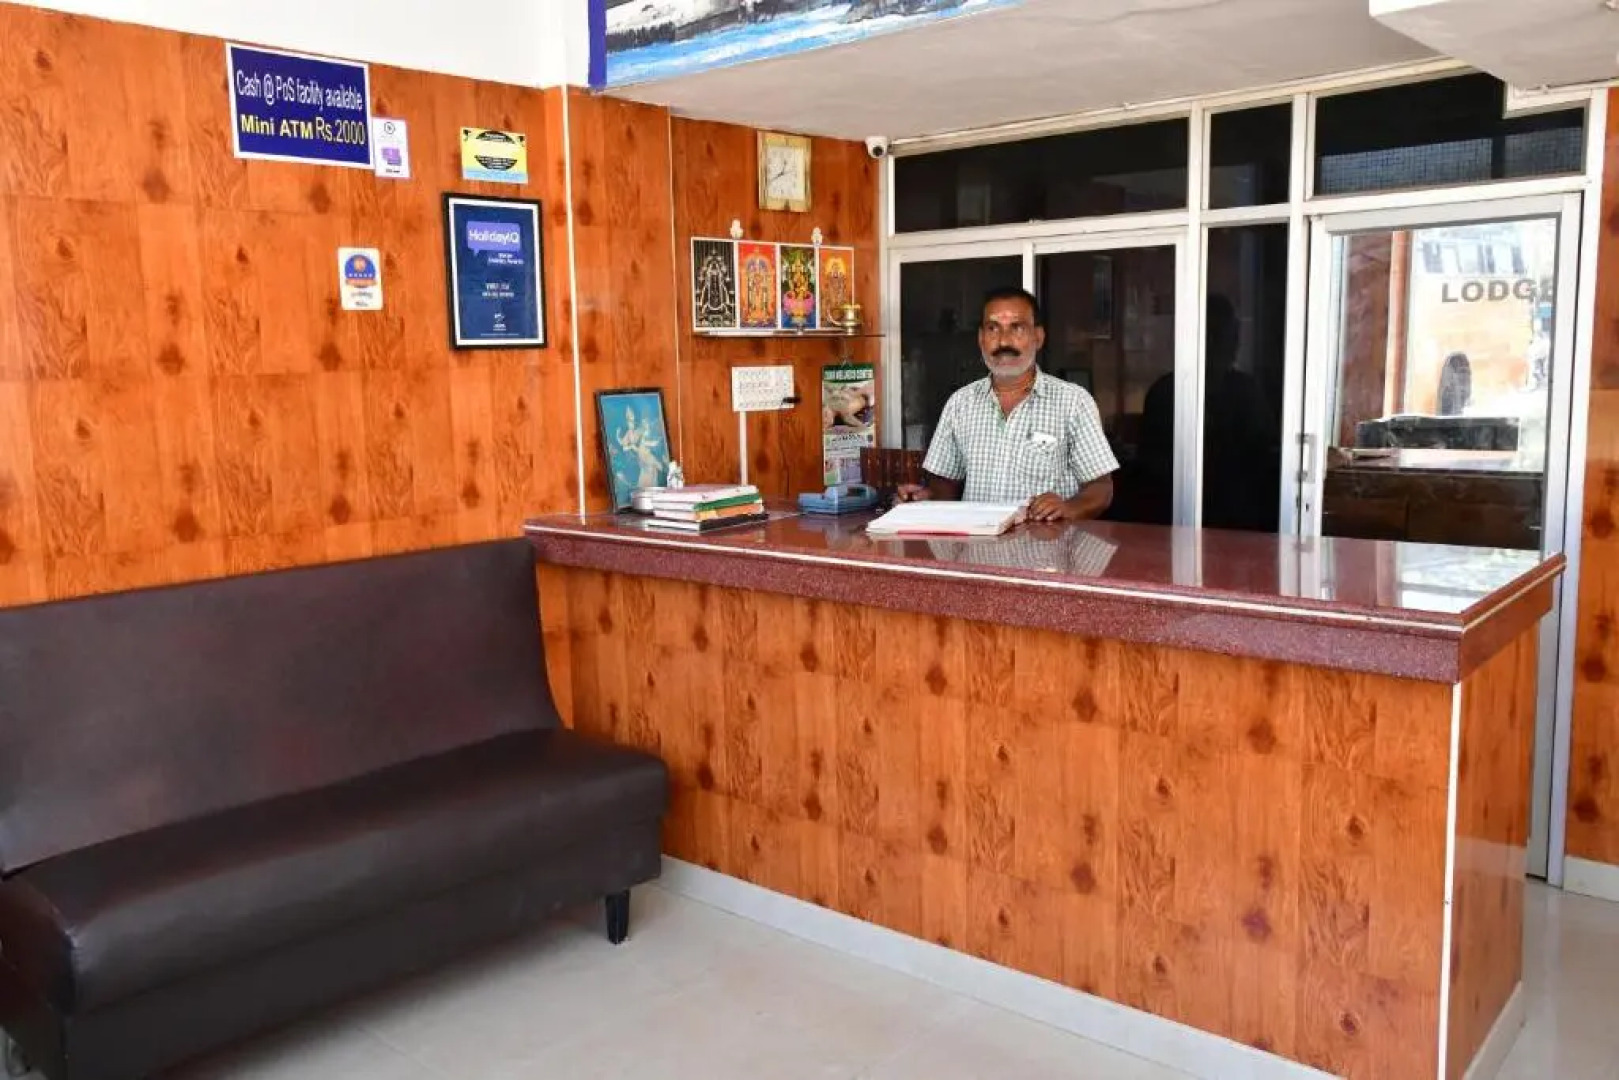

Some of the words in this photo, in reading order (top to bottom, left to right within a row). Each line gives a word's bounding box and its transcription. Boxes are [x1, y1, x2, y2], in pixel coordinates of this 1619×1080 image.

[236, 69, 261, 97] Cash
[263, 74, 275, 105] @
[276, 75, 295, 102] PoS
[297, 78, 323, 111] facility
[325, 83, 363, 110] available
[240, 113, 275, 135] Mini
[279, 119, 313, 139] ATM
[315, 117, 365, 144] Rs.2000
